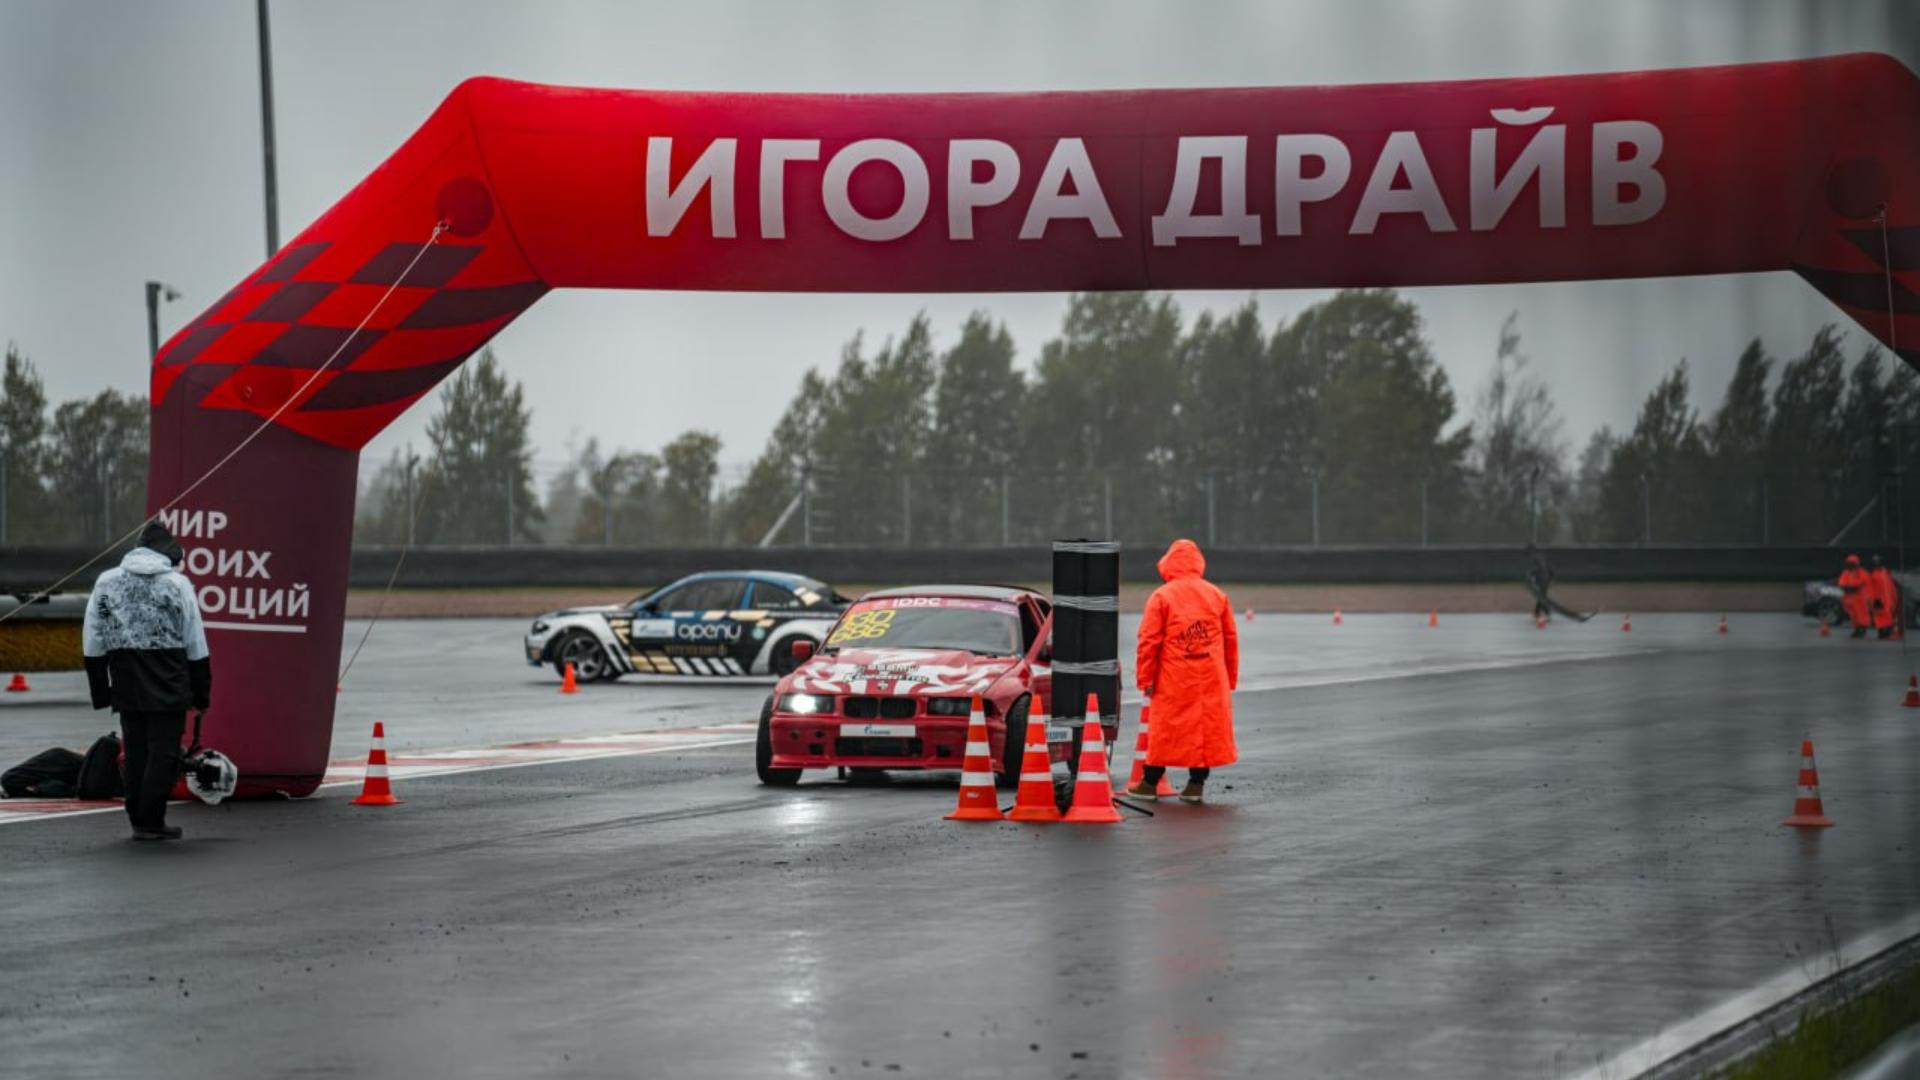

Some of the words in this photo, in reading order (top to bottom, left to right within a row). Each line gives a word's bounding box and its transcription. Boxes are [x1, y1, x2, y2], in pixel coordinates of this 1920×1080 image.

[645, 136, 1123, 241] ИГОРА
[1152, 107, 1667, 246] ДРАЙВ
[159, 508, 228, 538] МИР
